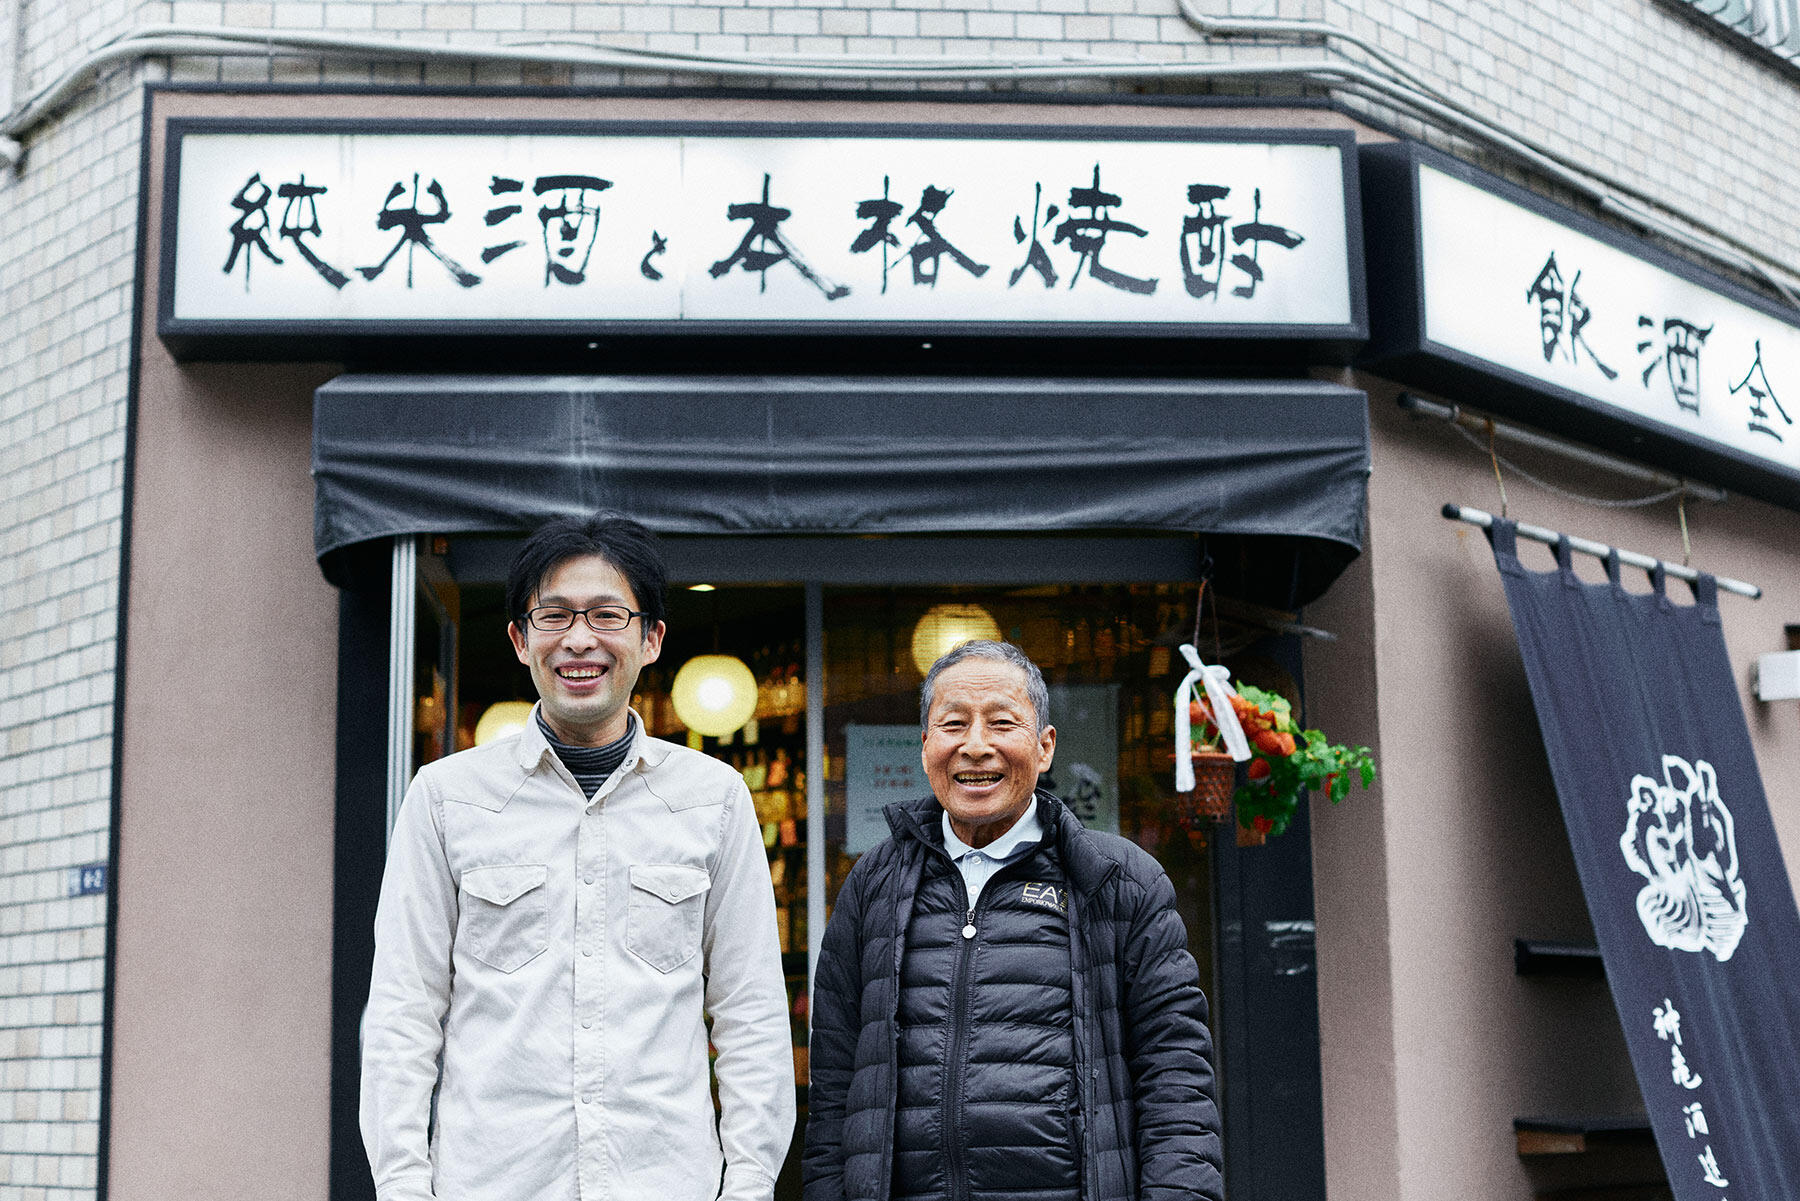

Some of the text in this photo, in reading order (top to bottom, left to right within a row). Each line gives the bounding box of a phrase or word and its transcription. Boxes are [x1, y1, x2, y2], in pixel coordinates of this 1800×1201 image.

[223, 164, 1305, 300] 純米酒と本格焼酎
